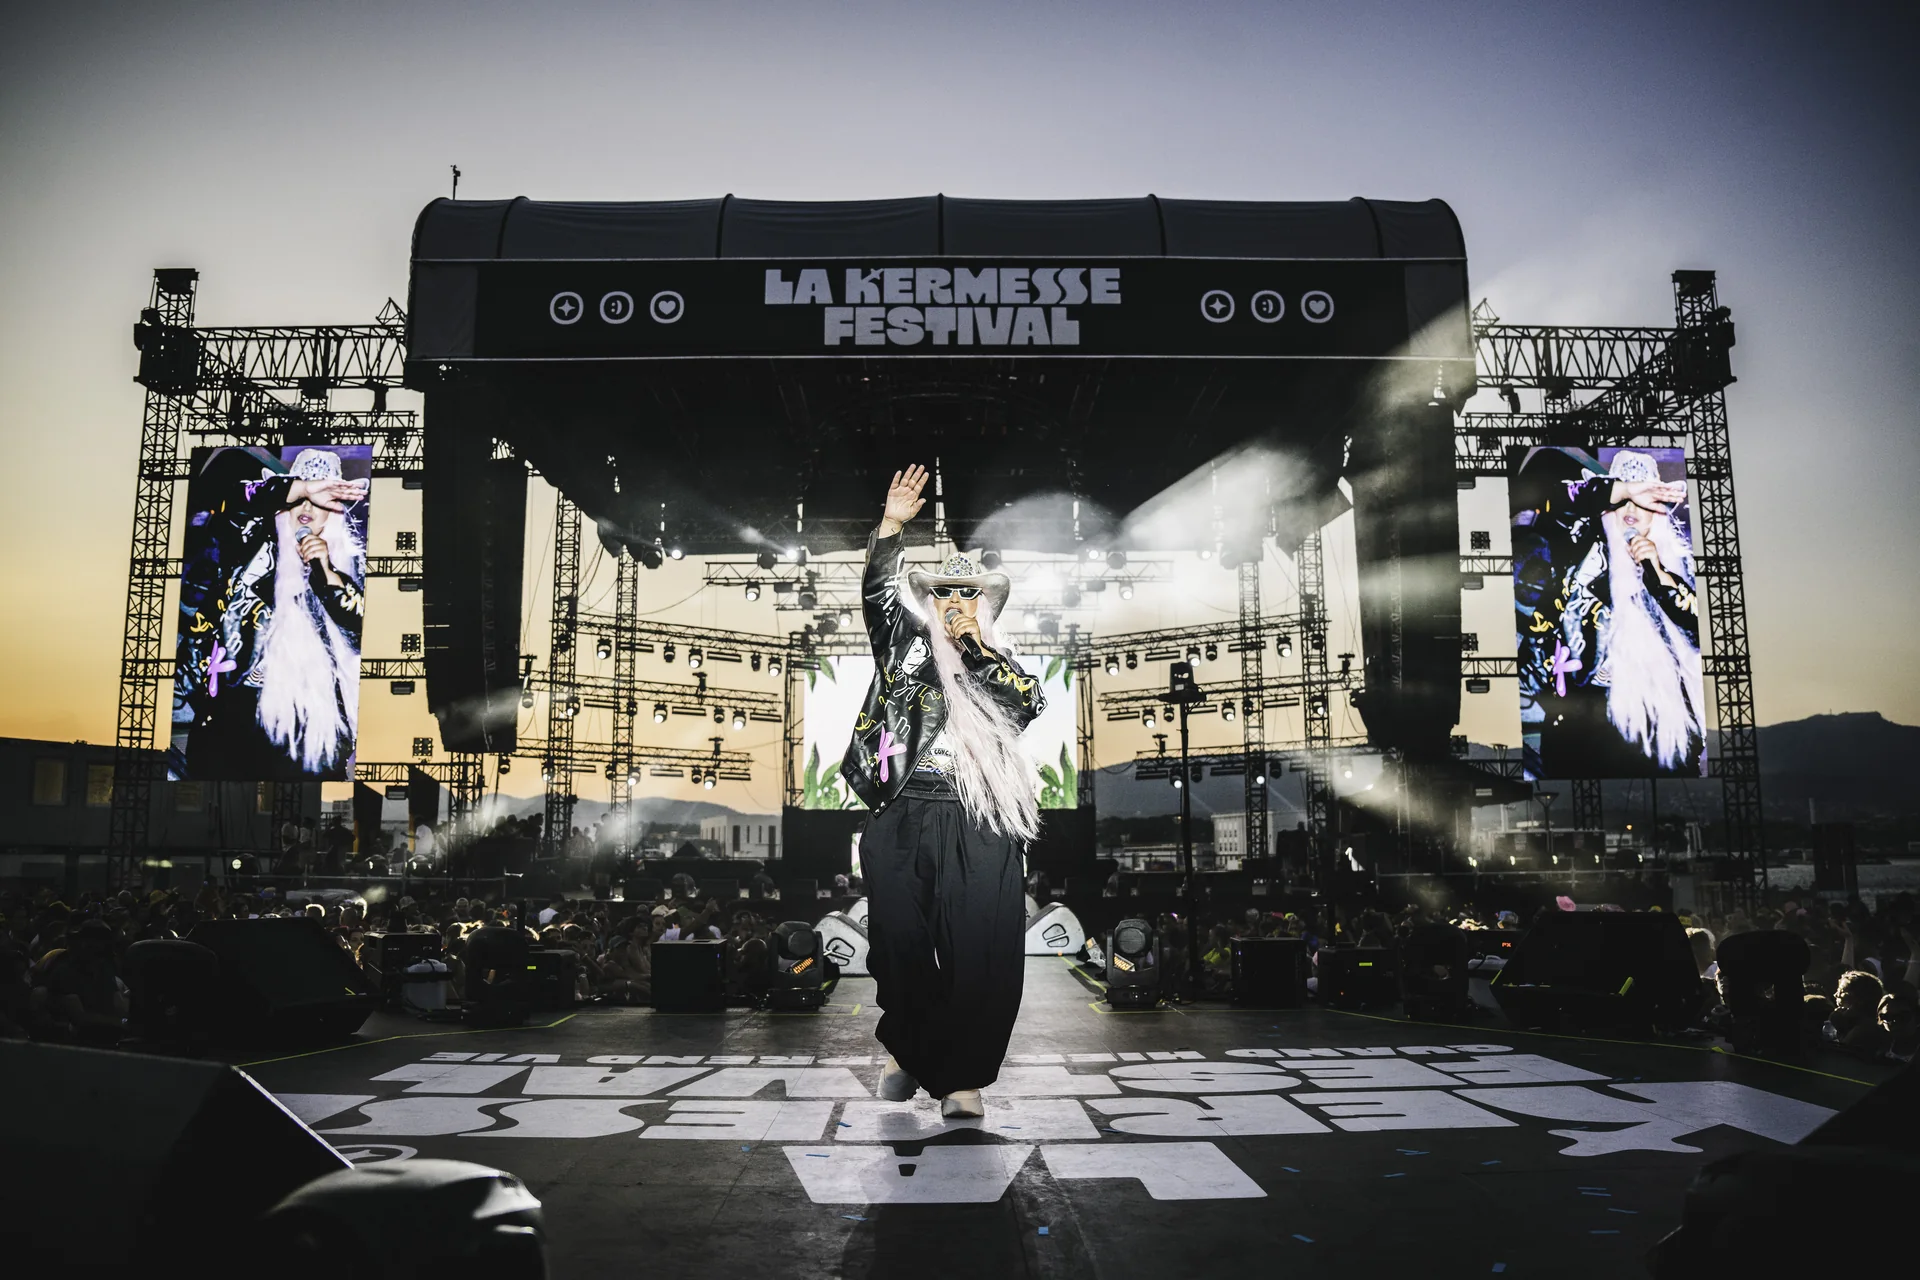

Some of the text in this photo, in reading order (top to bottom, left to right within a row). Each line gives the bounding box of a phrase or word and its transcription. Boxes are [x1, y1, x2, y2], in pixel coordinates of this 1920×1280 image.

[764, 267, 1122, 305] LA KERMESSE
[824, 306, 1080, 346] FESTIVAL
[420, 1051, 562, 1064] VIE
[1224, 1044, 1515, 1061] QUAND
[782, 1143, 1269, 1205] LA
